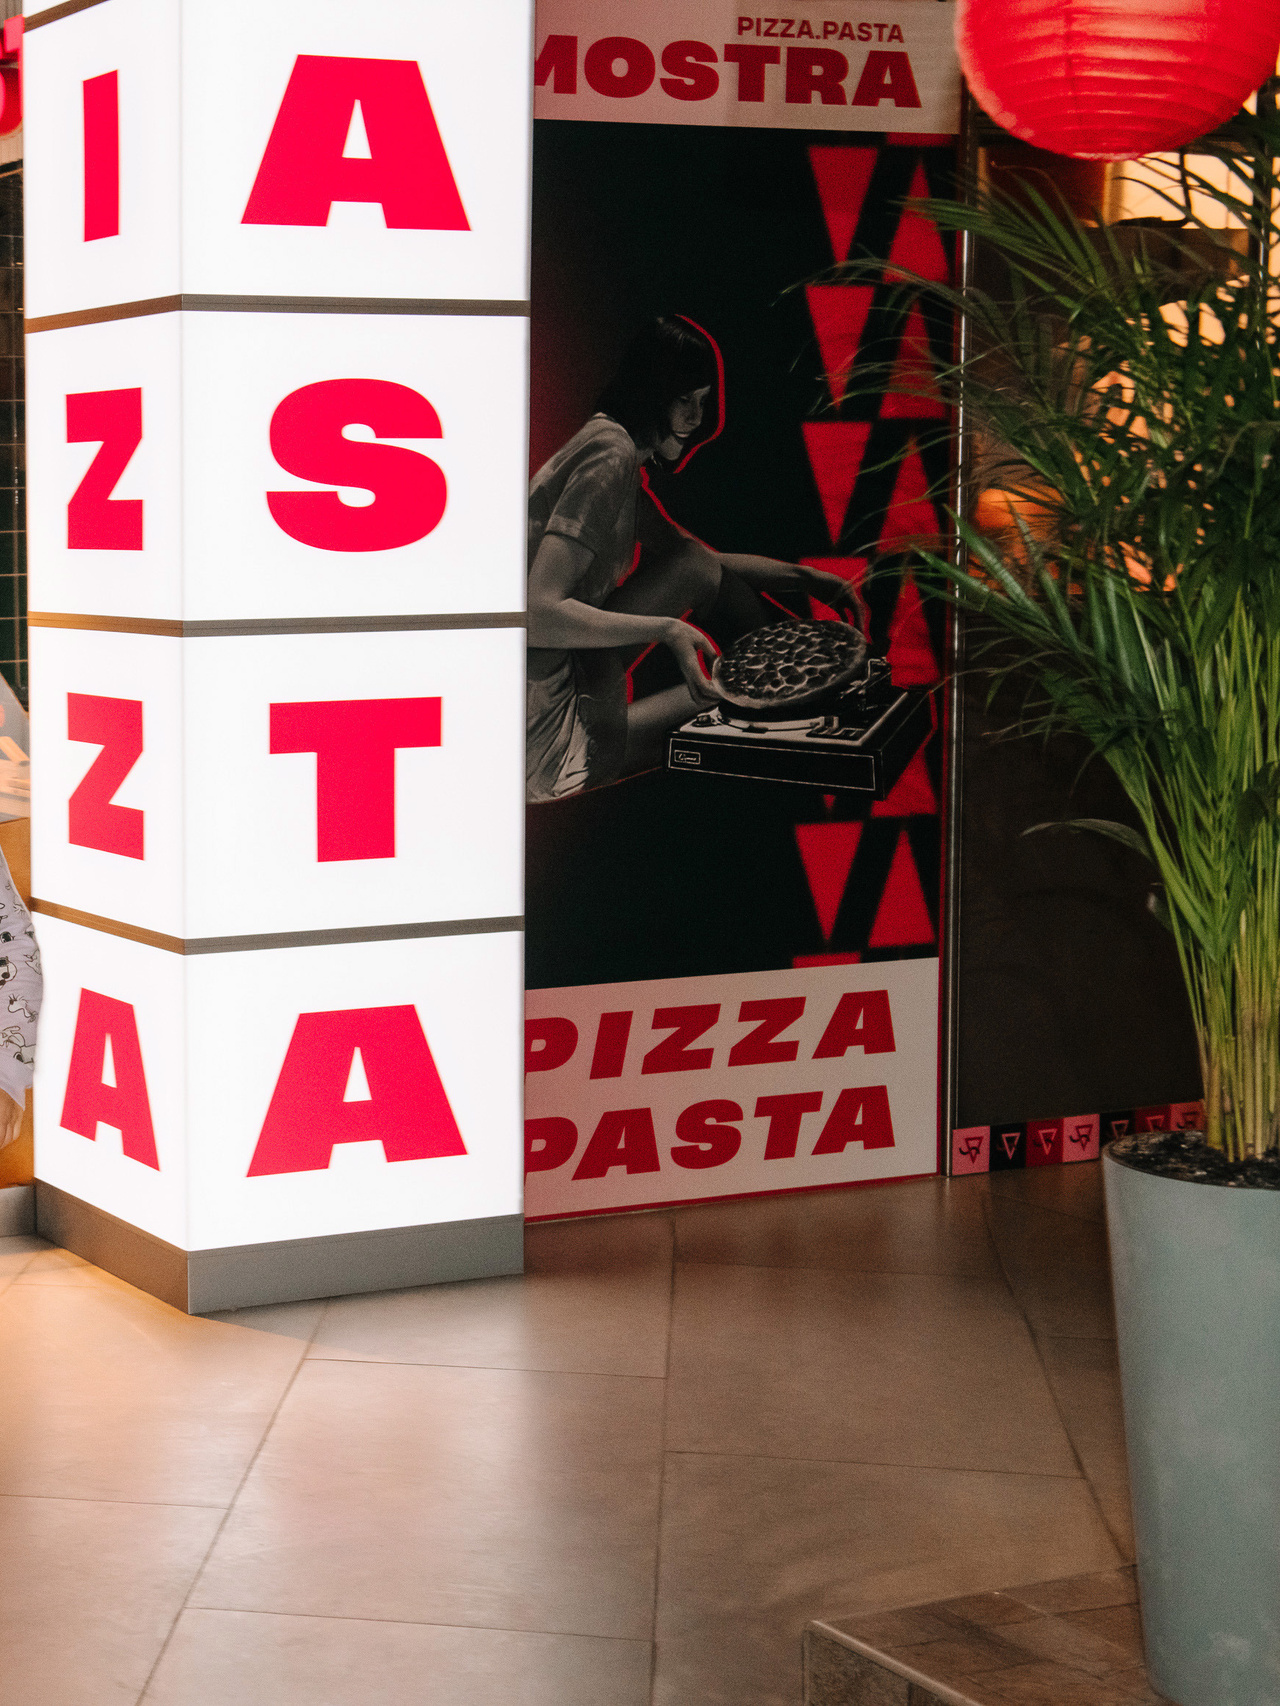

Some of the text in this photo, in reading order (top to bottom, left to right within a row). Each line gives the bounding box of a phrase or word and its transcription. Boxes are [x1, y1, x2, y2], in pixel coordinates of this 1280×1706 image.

[737, 16, 905, 43] PIZZA.PASTA
[524, 989, 896, 1084] PIZZA
[524, 1085, 896, 1184] PASTA
